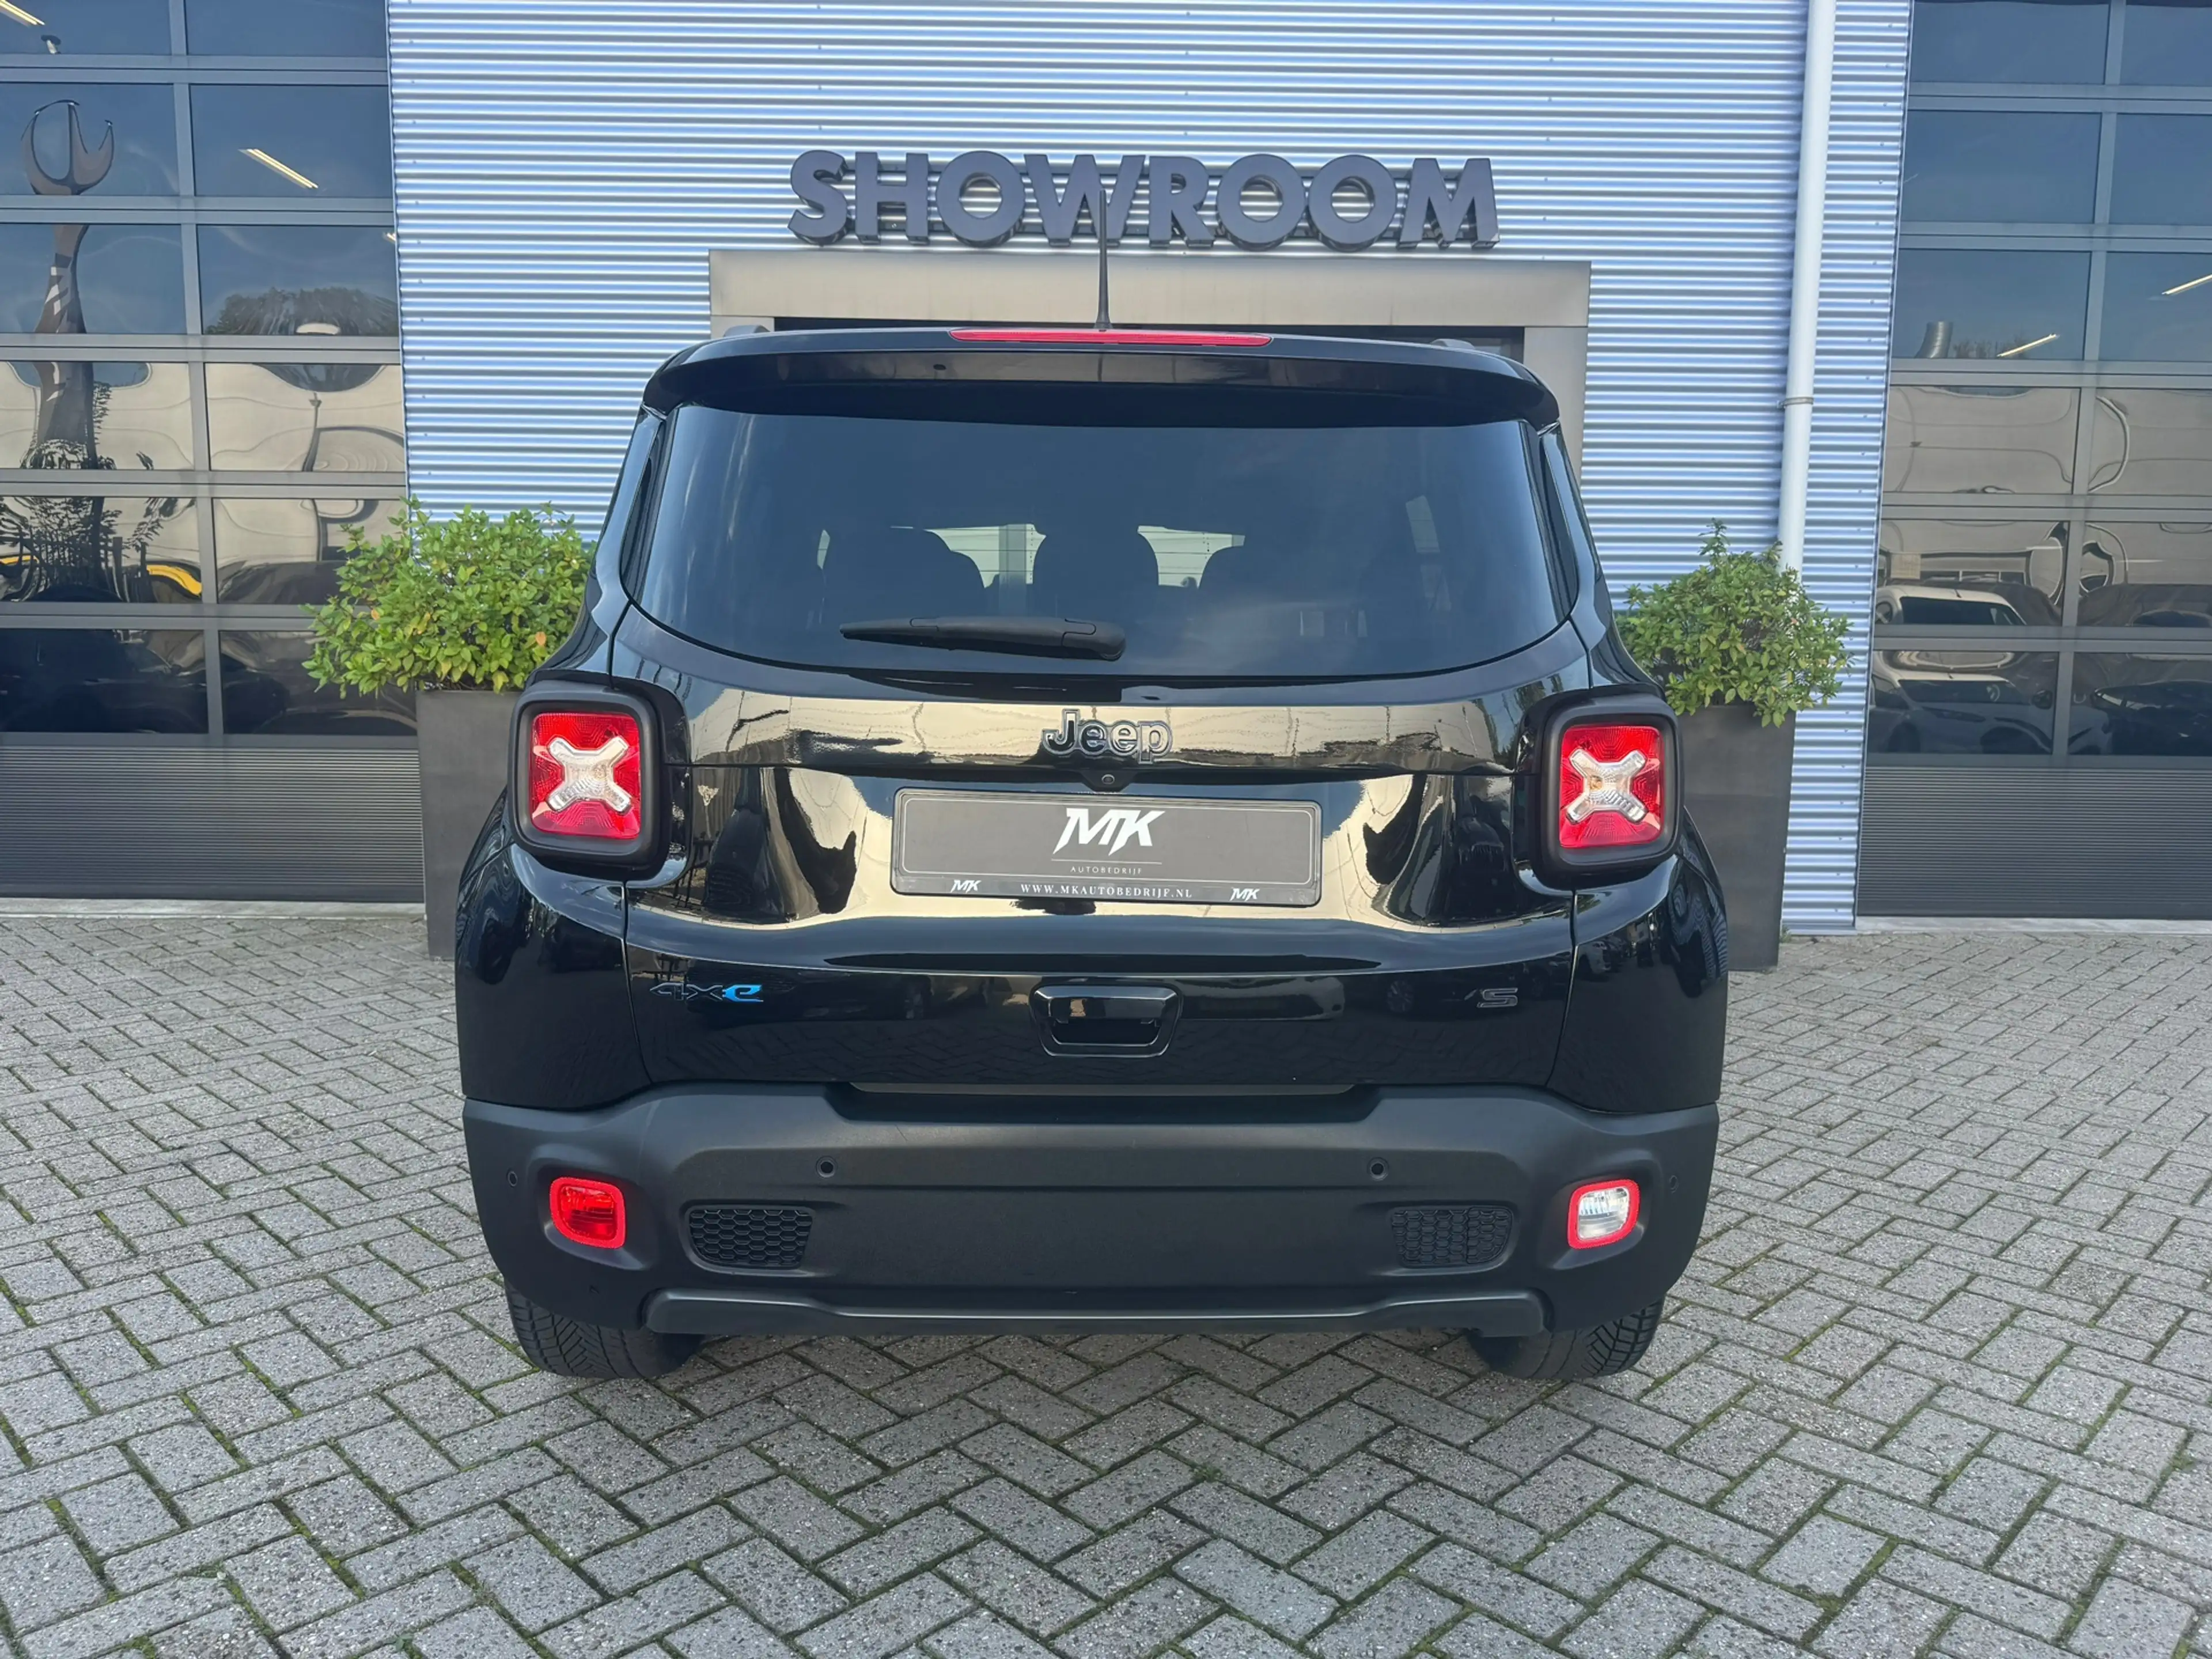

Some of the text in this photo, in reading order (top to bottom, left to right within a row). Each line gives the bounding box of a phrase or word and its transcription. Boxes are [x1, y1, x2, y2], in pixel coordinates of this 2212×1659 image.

[788, 151, 1499, 250] SHOWROOM
[1043, 709, 1173, 764] Jeep
[1052, 807, 1166, 857] MK
[1070, 866, 1143, 875] AUTOBEDRIJF
[950, 879, 981, 893] MK
[1021, 883, 1192, 899] WWW.MKAUTOBEDRIJF.NL
[1230, 887, 1260, 902] MK
